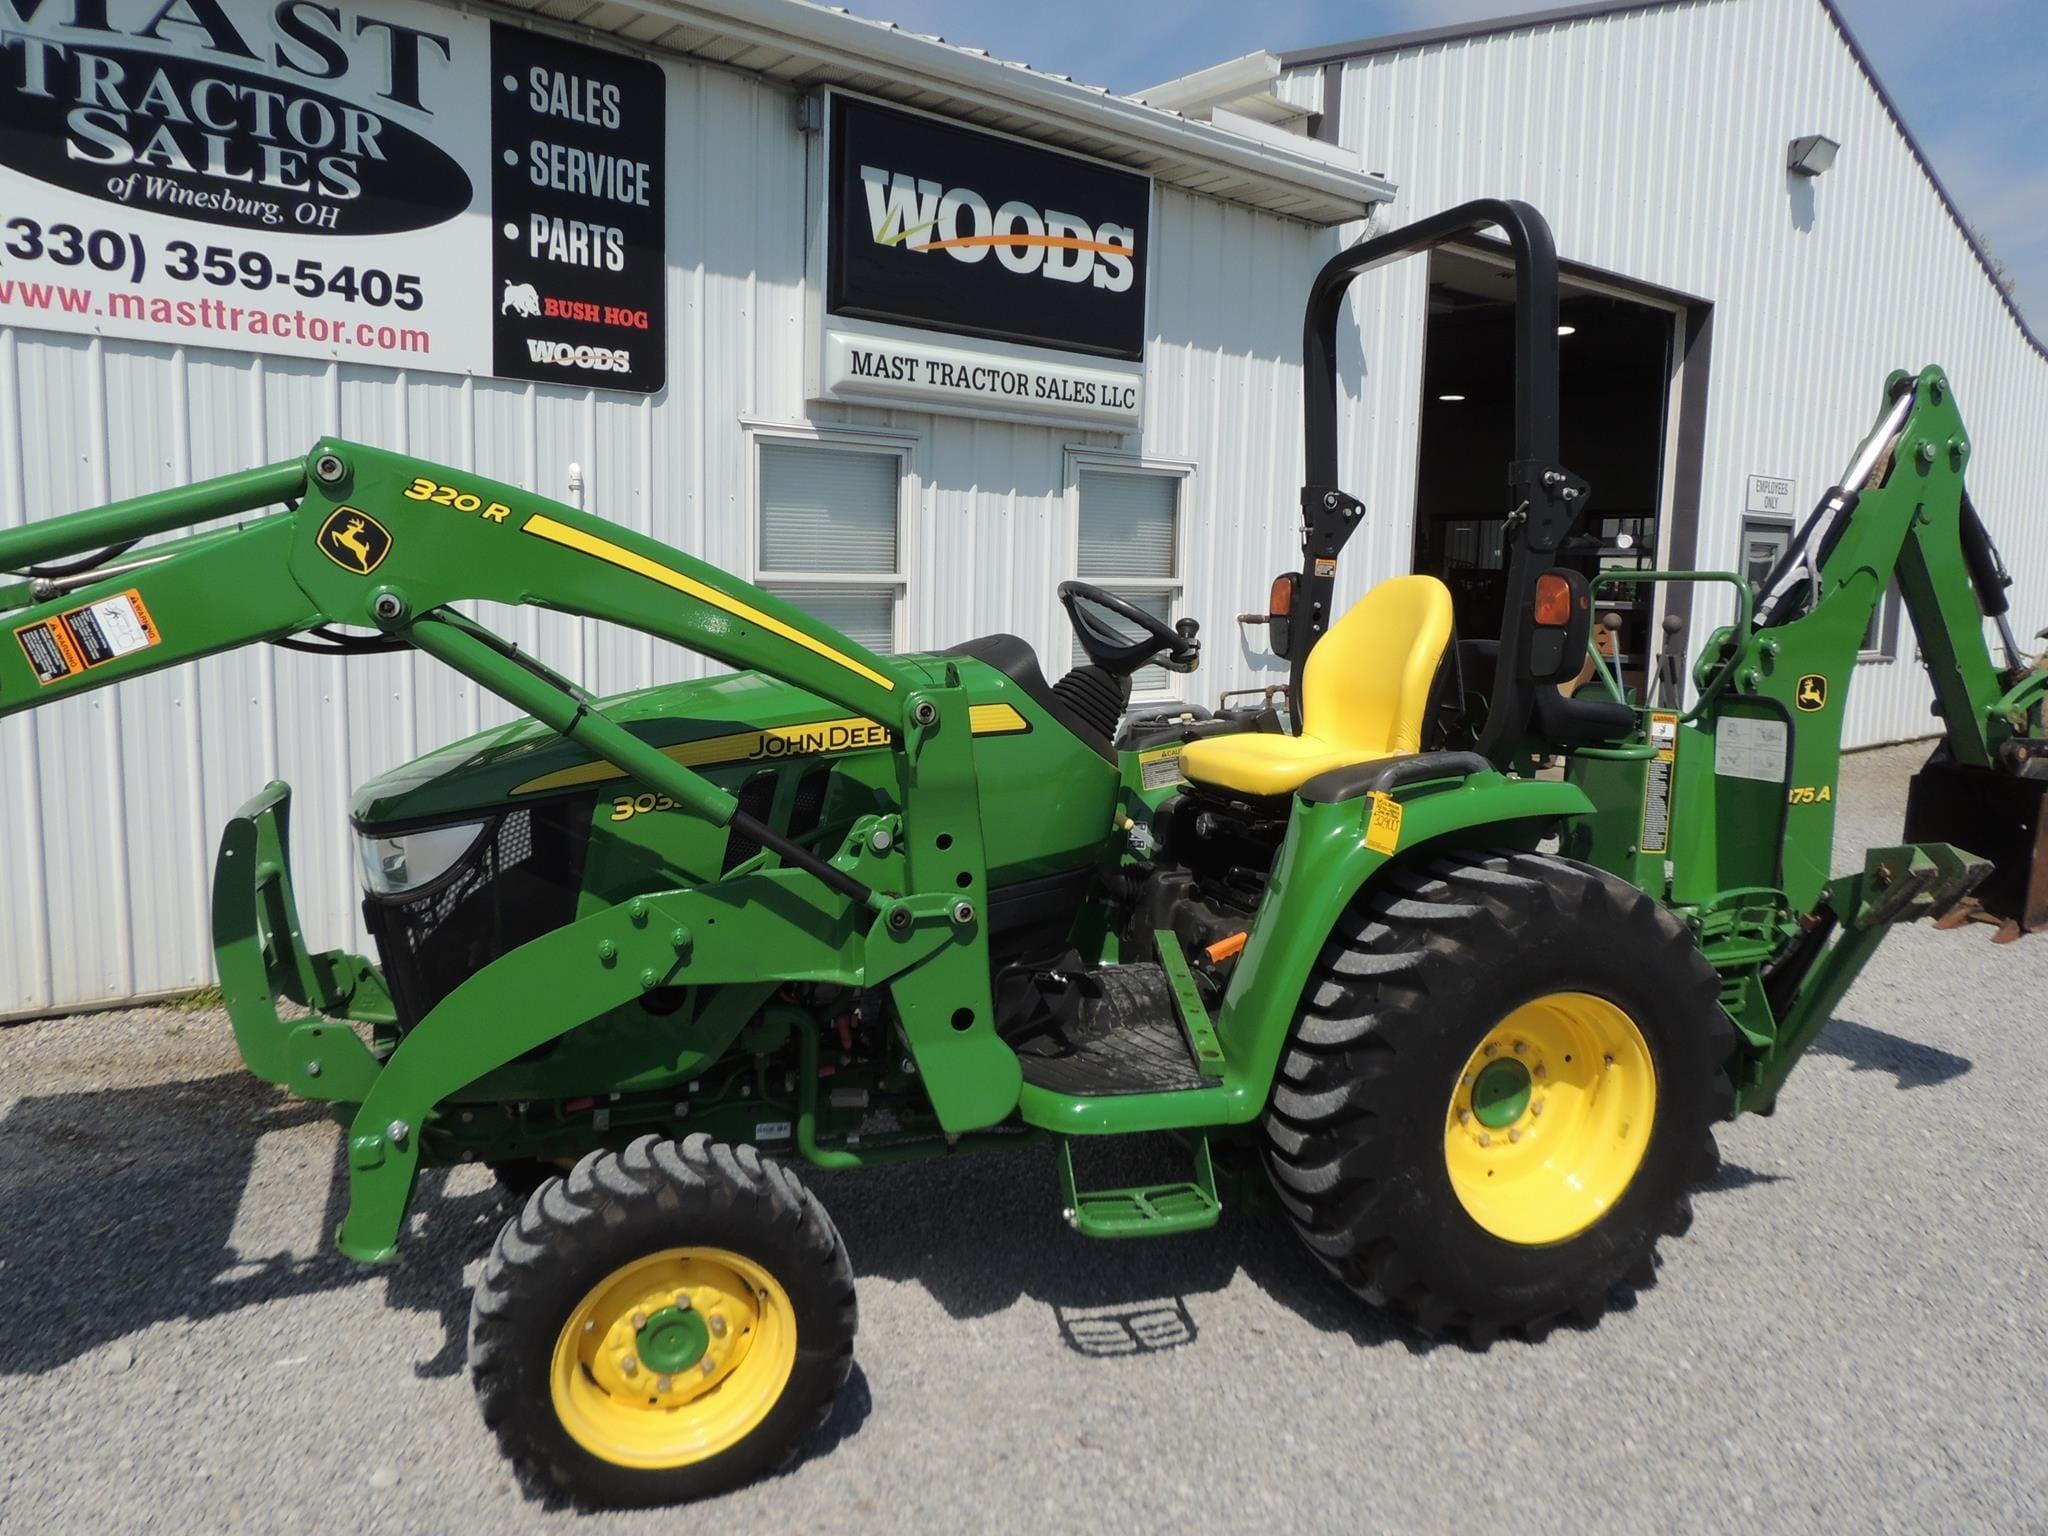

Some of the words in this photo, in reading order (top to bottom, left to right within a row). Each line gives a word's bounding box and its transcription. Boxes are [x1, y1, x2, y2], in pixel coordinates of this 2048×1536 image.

[3, 31, 387, 161] TRACTOR
[529, 66, 620, 129] SALES
[66, 107, 361, 199] SALES
[529, 140, 650, 206] SERVICE
[107, 173, 141, 201] of
[145, 175, 284, 224] Winesburg,
[294, 202, 341, 229] OH
[860, 164, 1135, 292] WOODS
[0, 217, 146, 284] 330)
[164, 240, 424, 311] 359-5405
[530, 213, 624, 271] PARTS
[544, 297, 600, 323] BUSH
[604, 306, 648, 329] HOG
[851, 350, 919, 381] MAST
[926, 361, 1029, 396] TRACTOR
[1035, 375, 1096, 404] SALES
[1101, 385, 1135, 409] LLC
[403, 478, 482, 512] 320
[481, 502, 512, 524] R
[1756, 480, 1788, 496] EMPLOYEES
[1764, 496, 1779, 509] ONLY
[749, 731, 824, 757] JOHN
